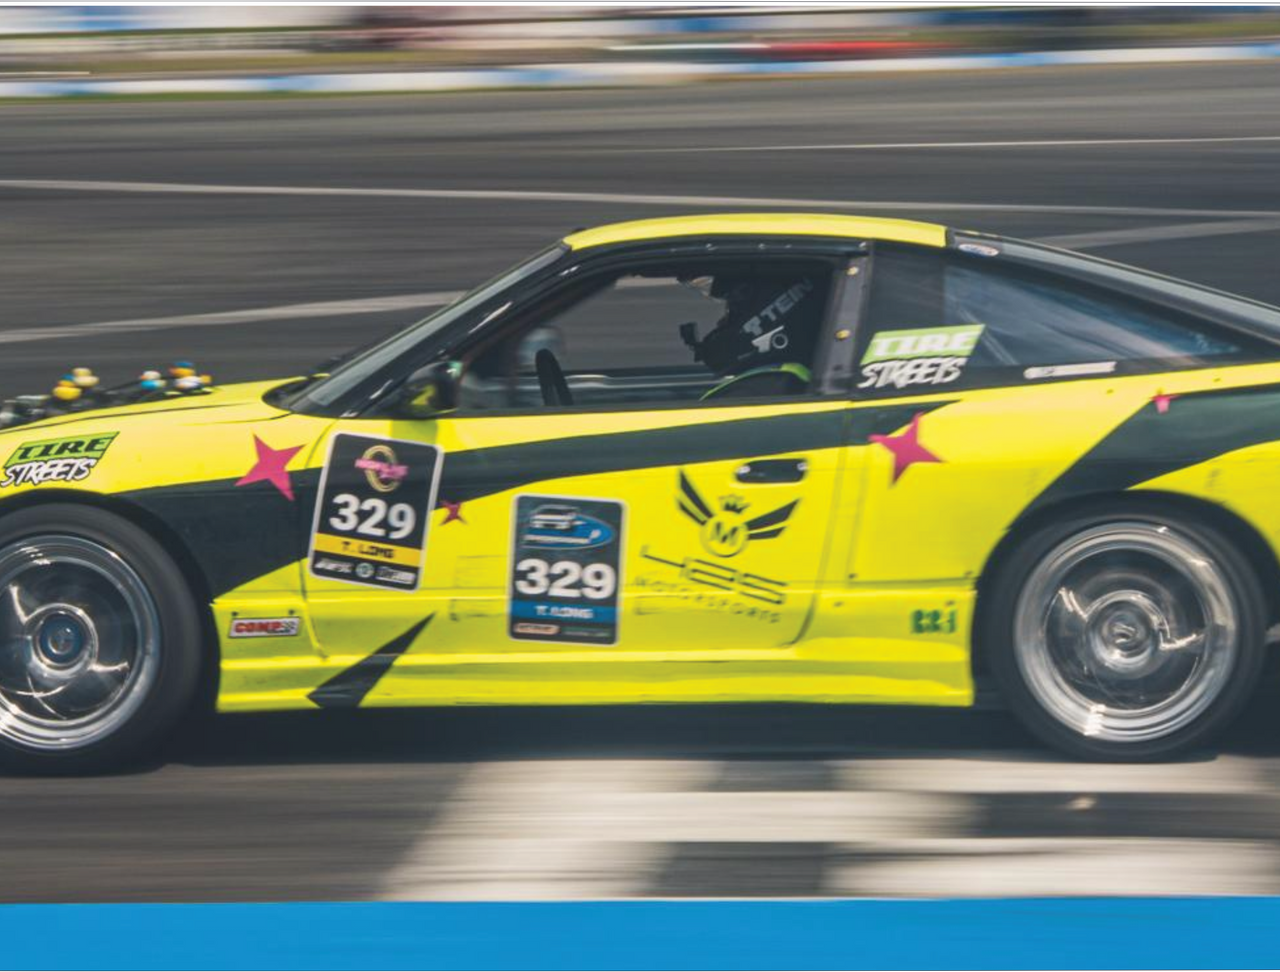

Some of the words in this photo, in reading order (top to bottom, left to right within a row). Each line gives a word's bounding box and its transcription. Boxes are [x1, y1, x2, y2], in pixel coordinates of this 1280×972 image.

[871, 332, 981, 357] TIRE
[856, 356, 968, 389] STREETS
[17, 435, 114, 461] TIRE
[0, 457, 97, 488] STREETS
[328, 493, 417, 540] 329
[515, 558, 616, 600] 329
